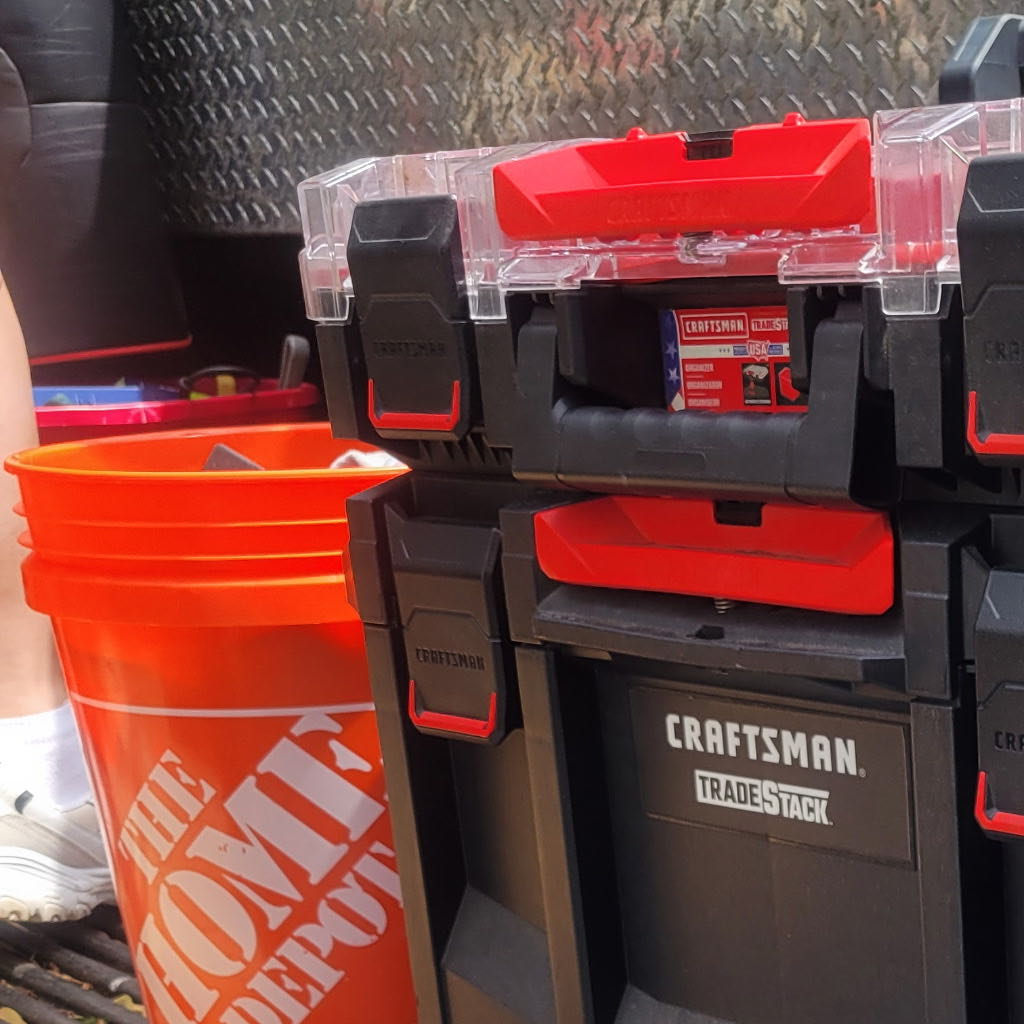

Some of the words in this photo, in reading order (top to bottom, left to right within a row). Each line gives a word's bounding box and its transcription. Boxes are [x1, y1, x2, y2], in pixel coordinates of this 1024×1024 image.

[685, 319, 744, 334] CRAFTSMAN
[749, 345, 767, 357] USA
[416, 648, 486, 671] CRAFTSMAN
[665, 713, 858, 776] CRAFTSMAN
[118, 748, 218, 886] THE
